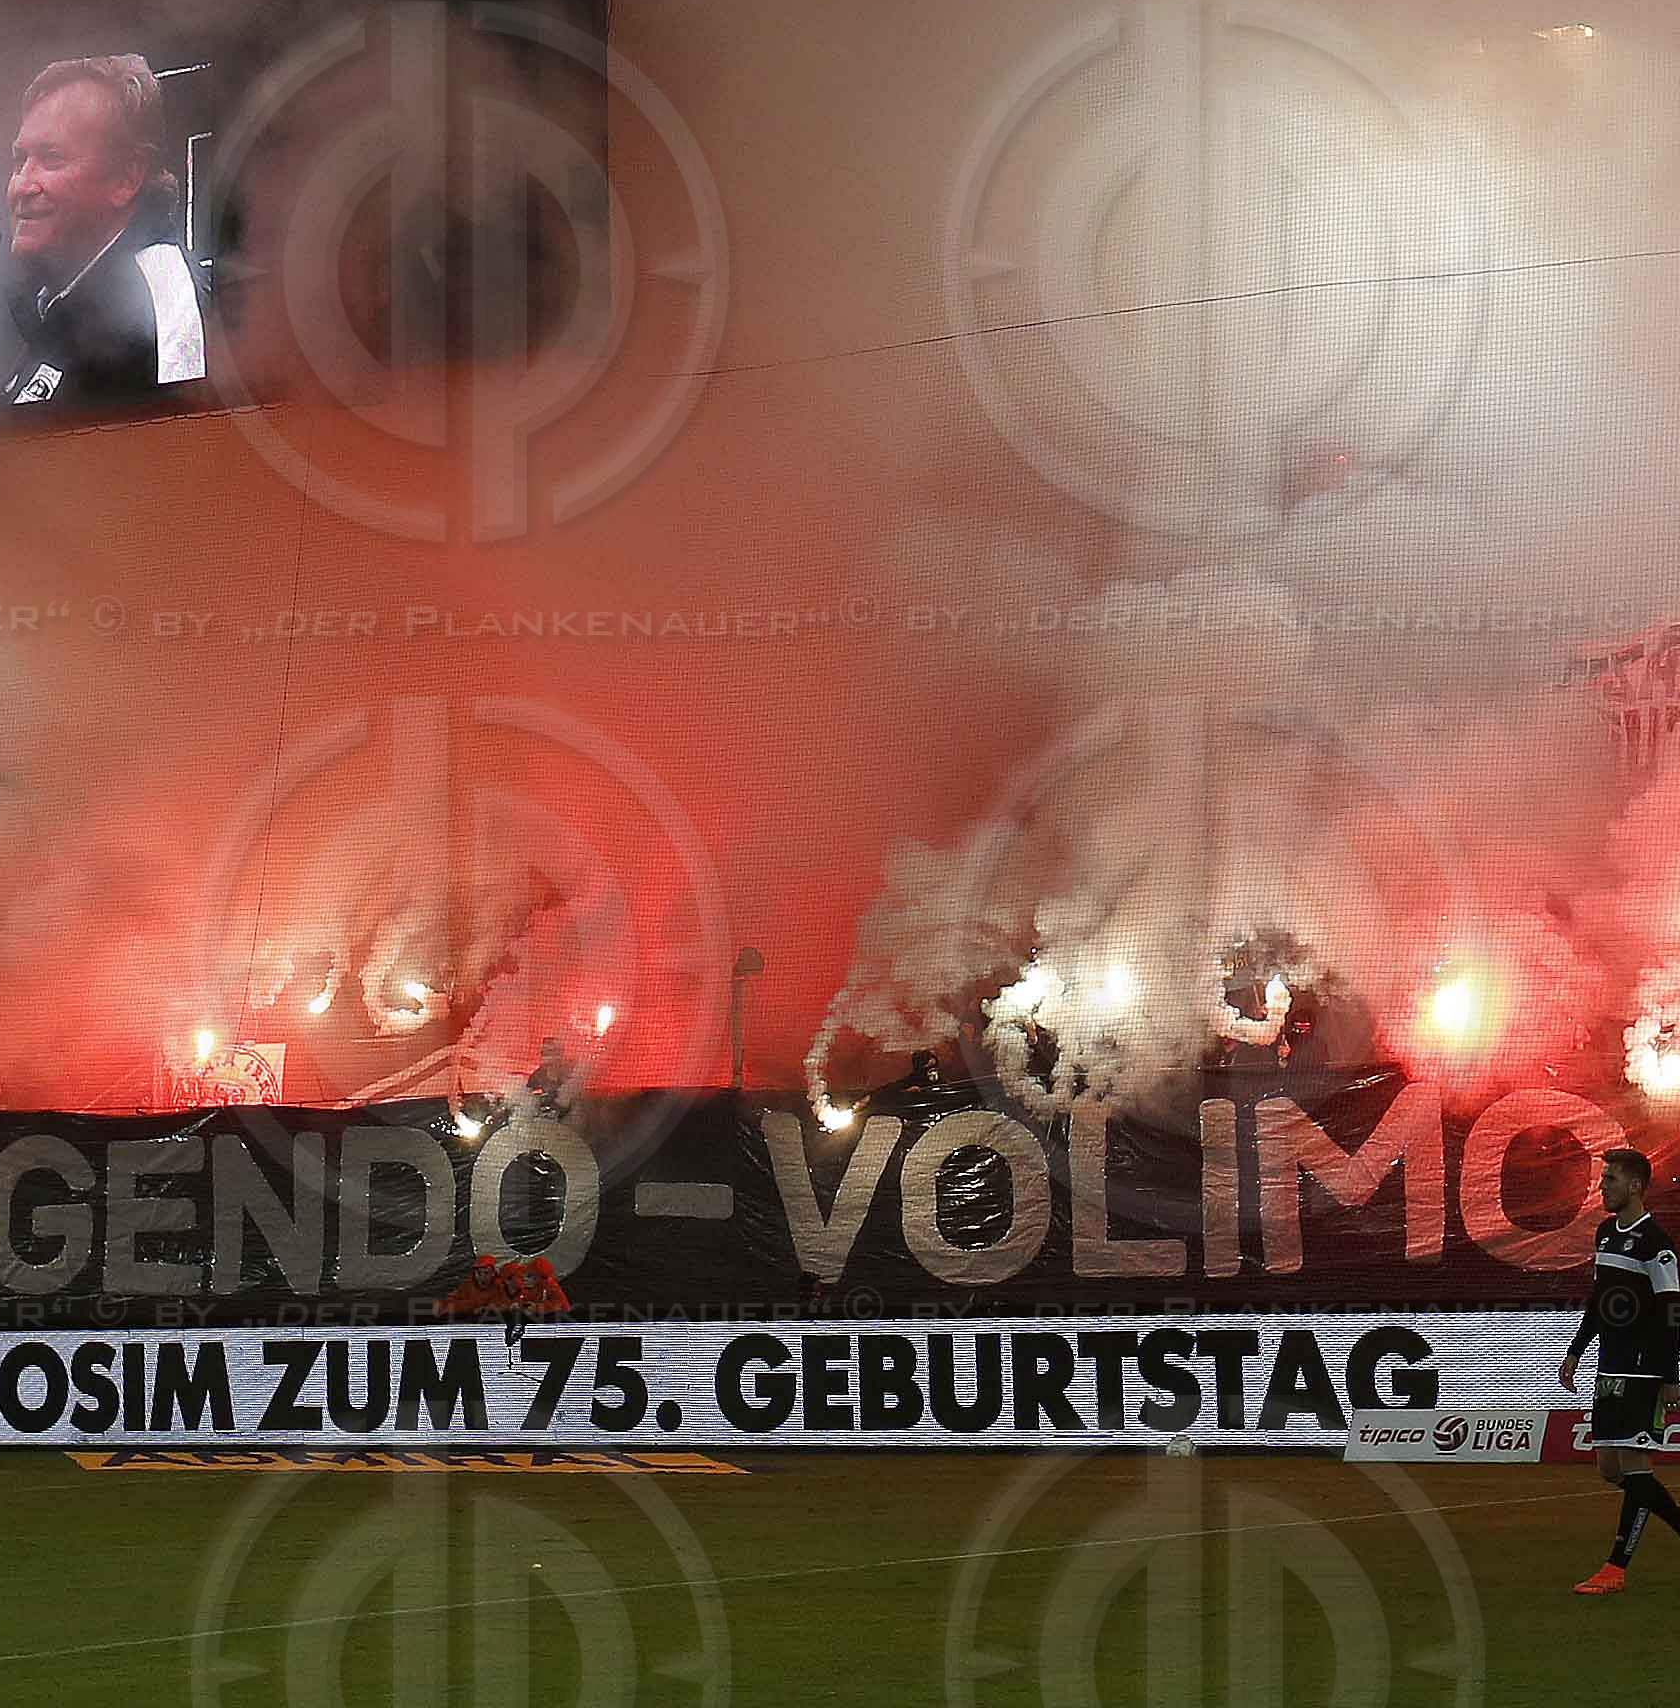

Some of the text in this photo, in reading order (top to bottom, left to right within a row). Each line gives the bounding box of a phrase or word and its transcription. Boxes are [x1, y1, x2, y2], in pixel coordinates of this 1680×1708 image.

[761, 1082, 1629, 1284] VOLIMO
[261, 1339, 488, 1434] ZUM
[518, 1336, 682, 1434] 75.
[717, 1326, 1440, 1435] GEBURTSTAG
[1359, 1418, 1534, 1447] tipico BUNDES
[1472, 1431, 1531, 1450] LIGA
